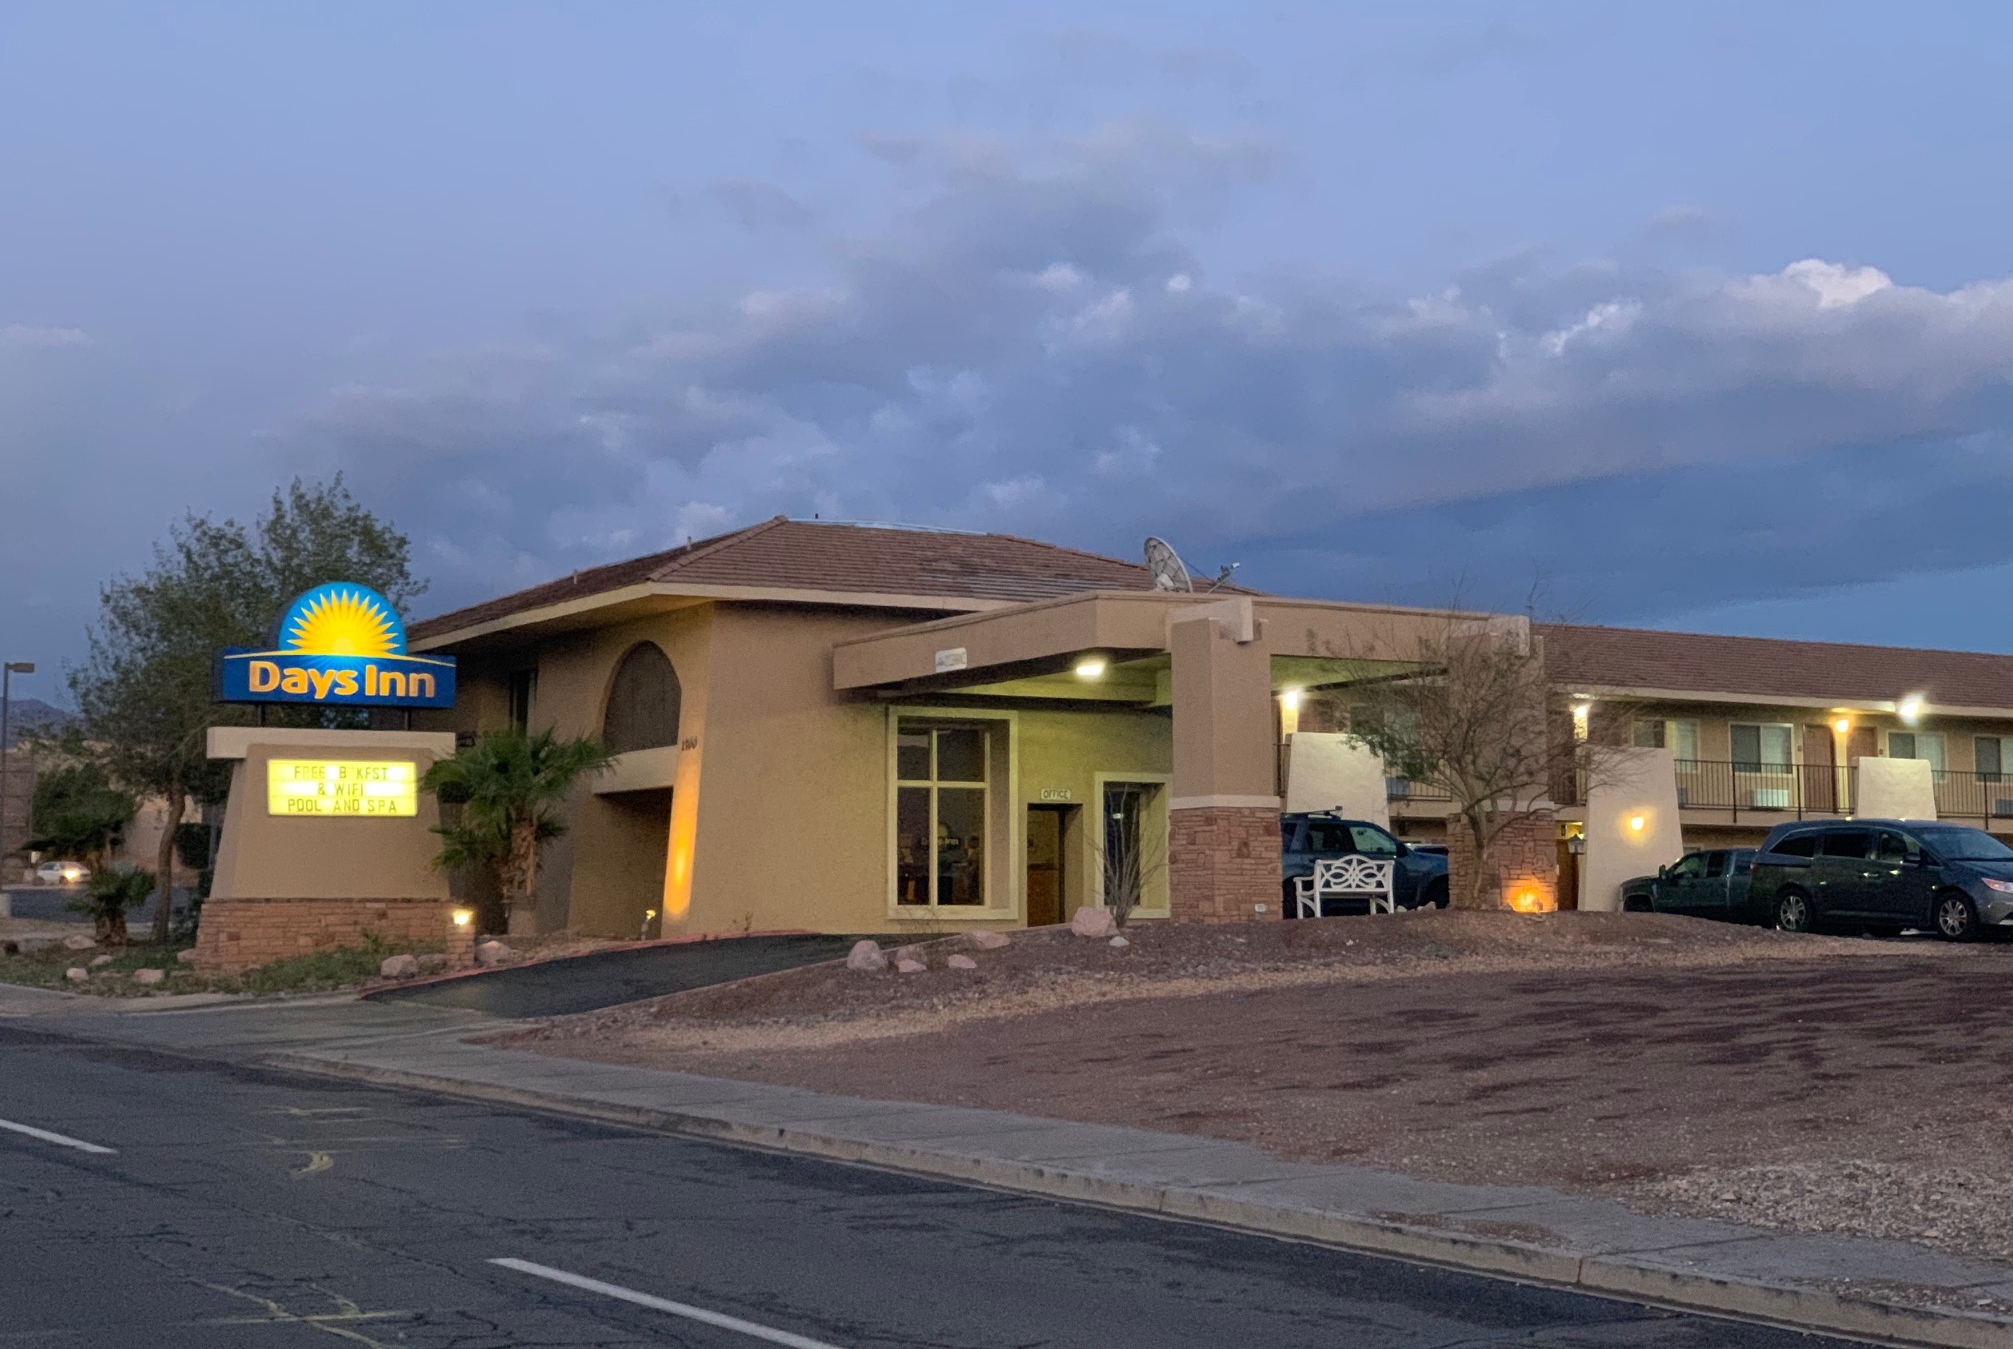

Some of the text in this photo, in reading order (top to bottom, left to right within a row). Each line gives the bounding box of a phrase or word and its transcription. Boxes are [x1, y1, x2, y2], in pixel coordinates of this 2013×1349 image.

[249, 660, 435, 699] Days Inn
[294, 766, 326, 779] FREE
[318, 783, 364, 796] & WIFI
[288, 798, 397, 813] POOL AND SPA
